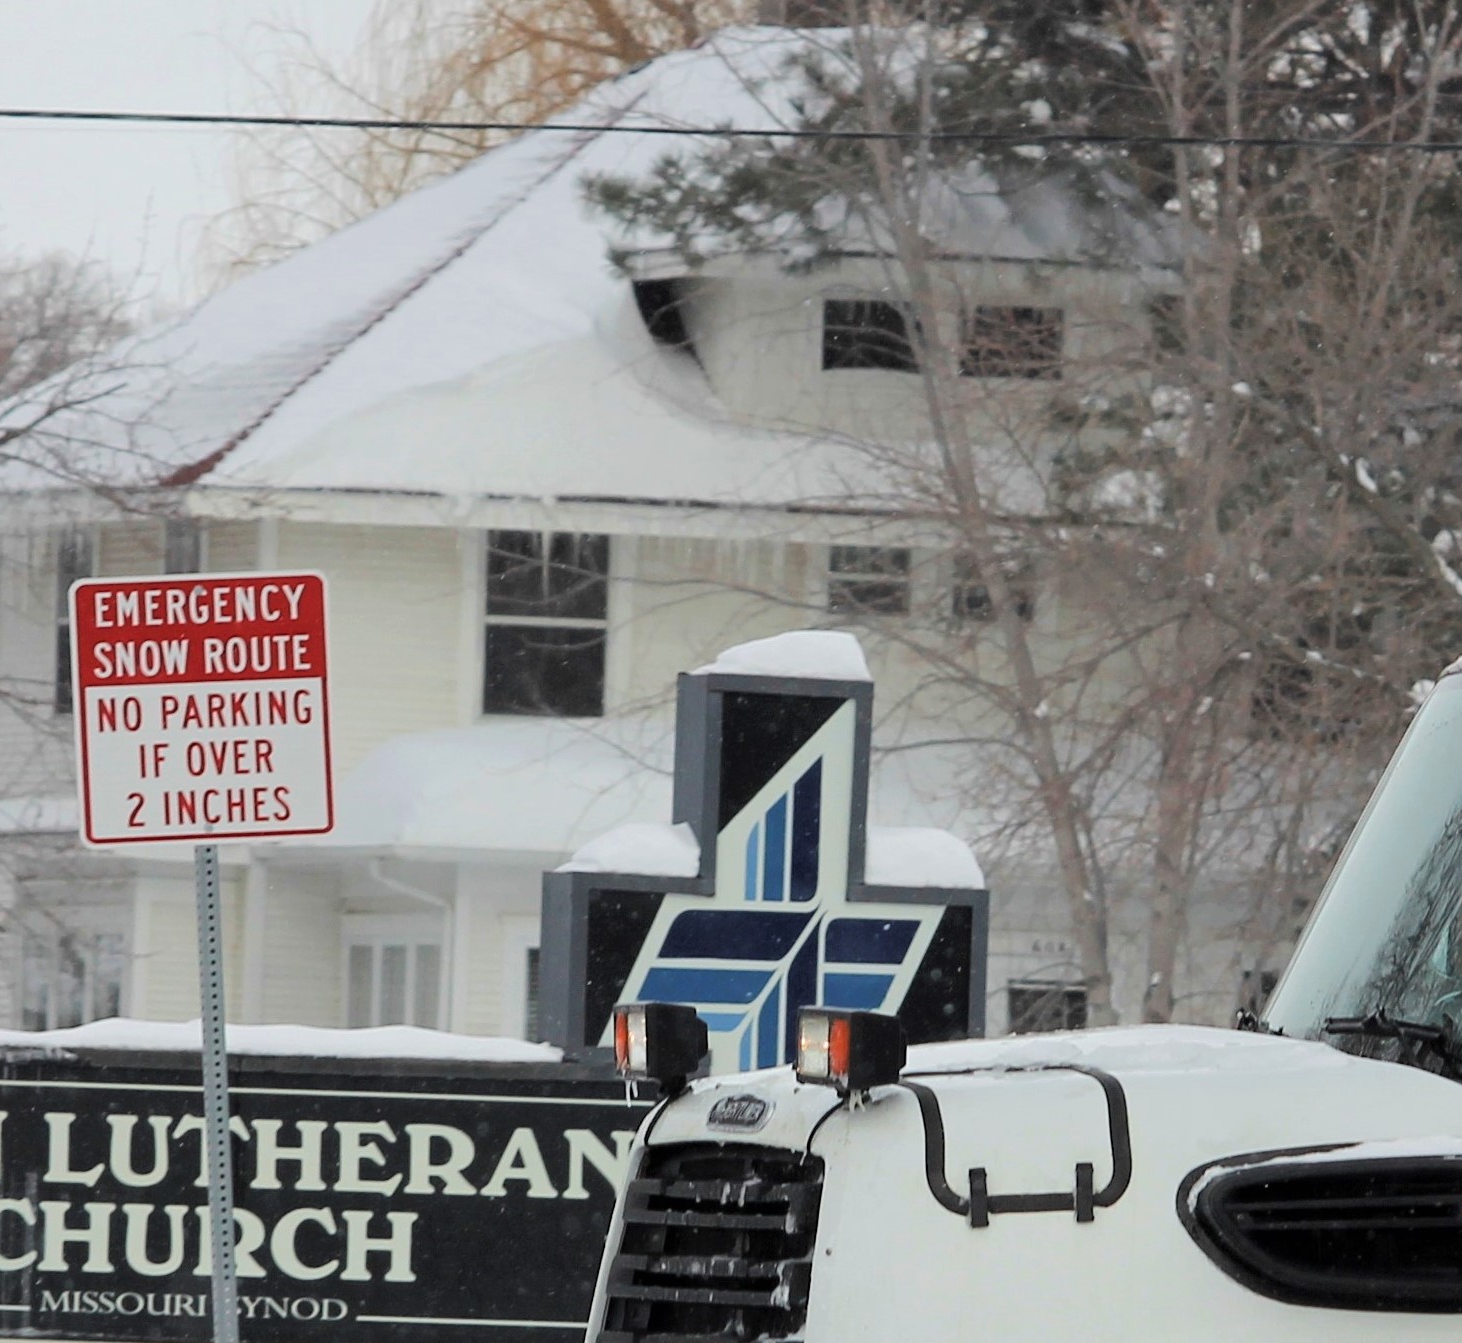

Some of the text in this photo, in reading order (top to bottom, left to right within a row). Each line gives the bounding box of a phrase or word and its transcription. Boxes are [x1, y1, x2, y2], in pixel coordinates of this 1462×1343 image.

[94, 583, 305, 628] EMERGENCY
[93, 634, 312, 678] SNOW ROUTE
[97, 689, 313, 732] NO PARKING
[140, 739, 274, 778] IF OVER
[127, 786, 291, 827] 2 INCHES
[43, 1111, 637, 1199] LUTHERAN
[40, 1289, 349, 1321] MISSOURI YNOD
